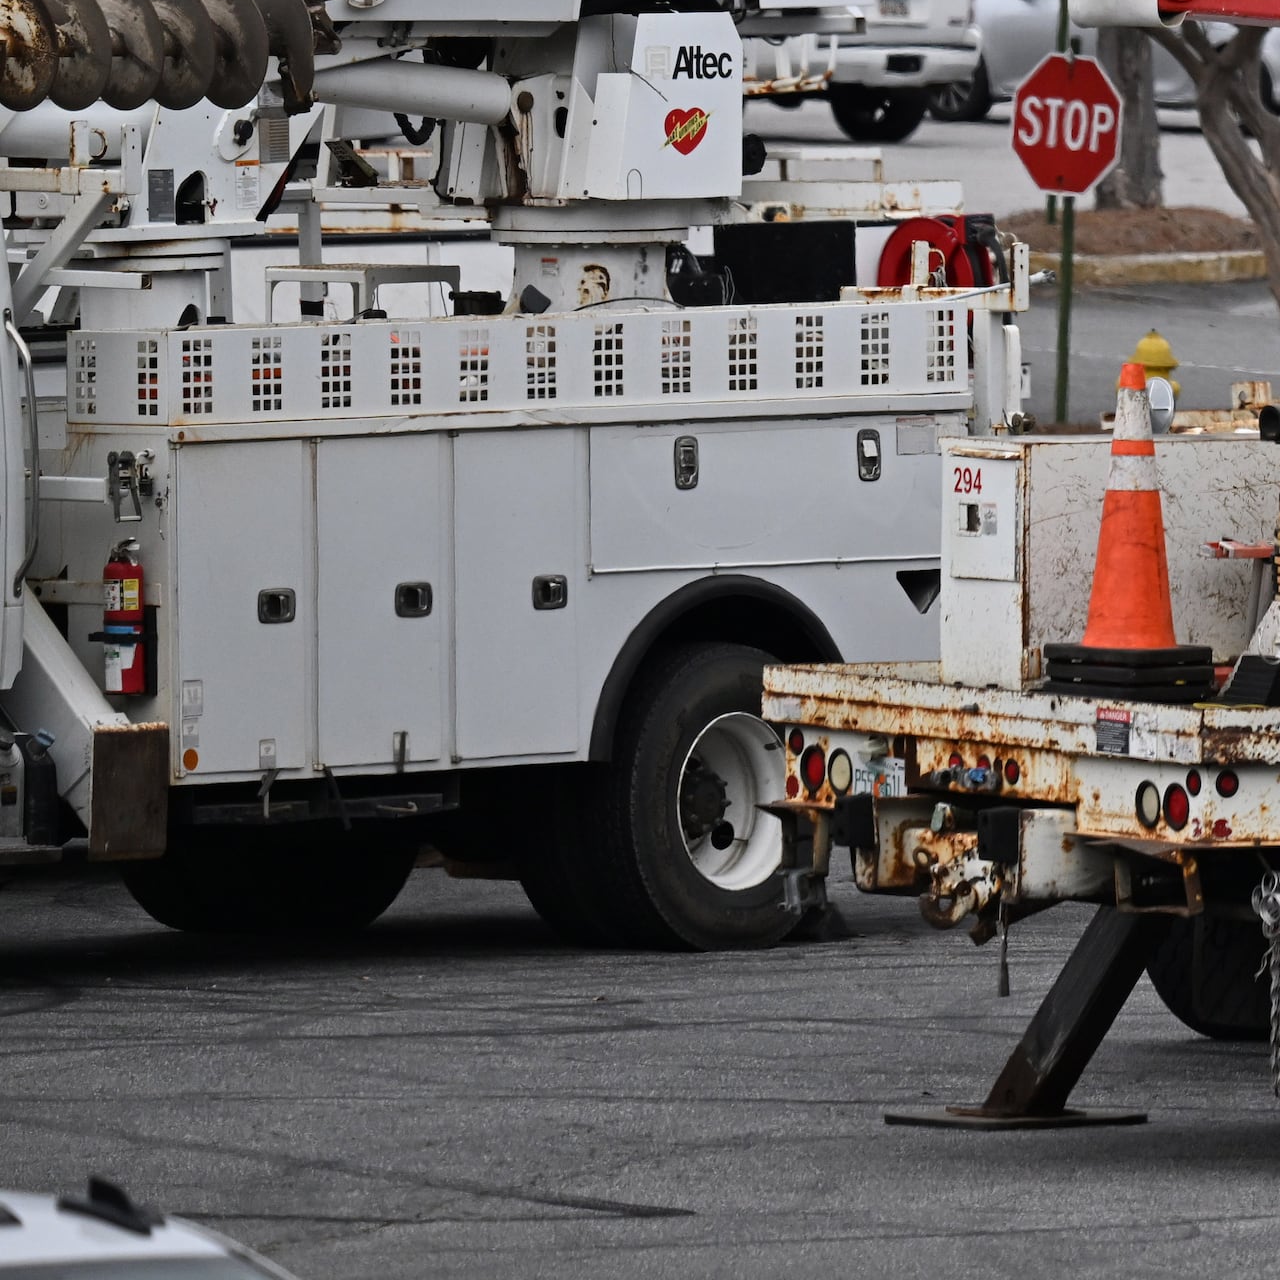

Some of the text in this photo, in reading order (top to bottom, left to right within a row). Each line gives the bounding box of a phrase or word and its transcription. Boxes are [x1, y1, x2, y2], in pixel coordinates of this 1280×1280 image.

[672, 45, 733, 80] Altec
[1018, 95, 1115, 153] STOP
[954, 467, 982, 494] 294
